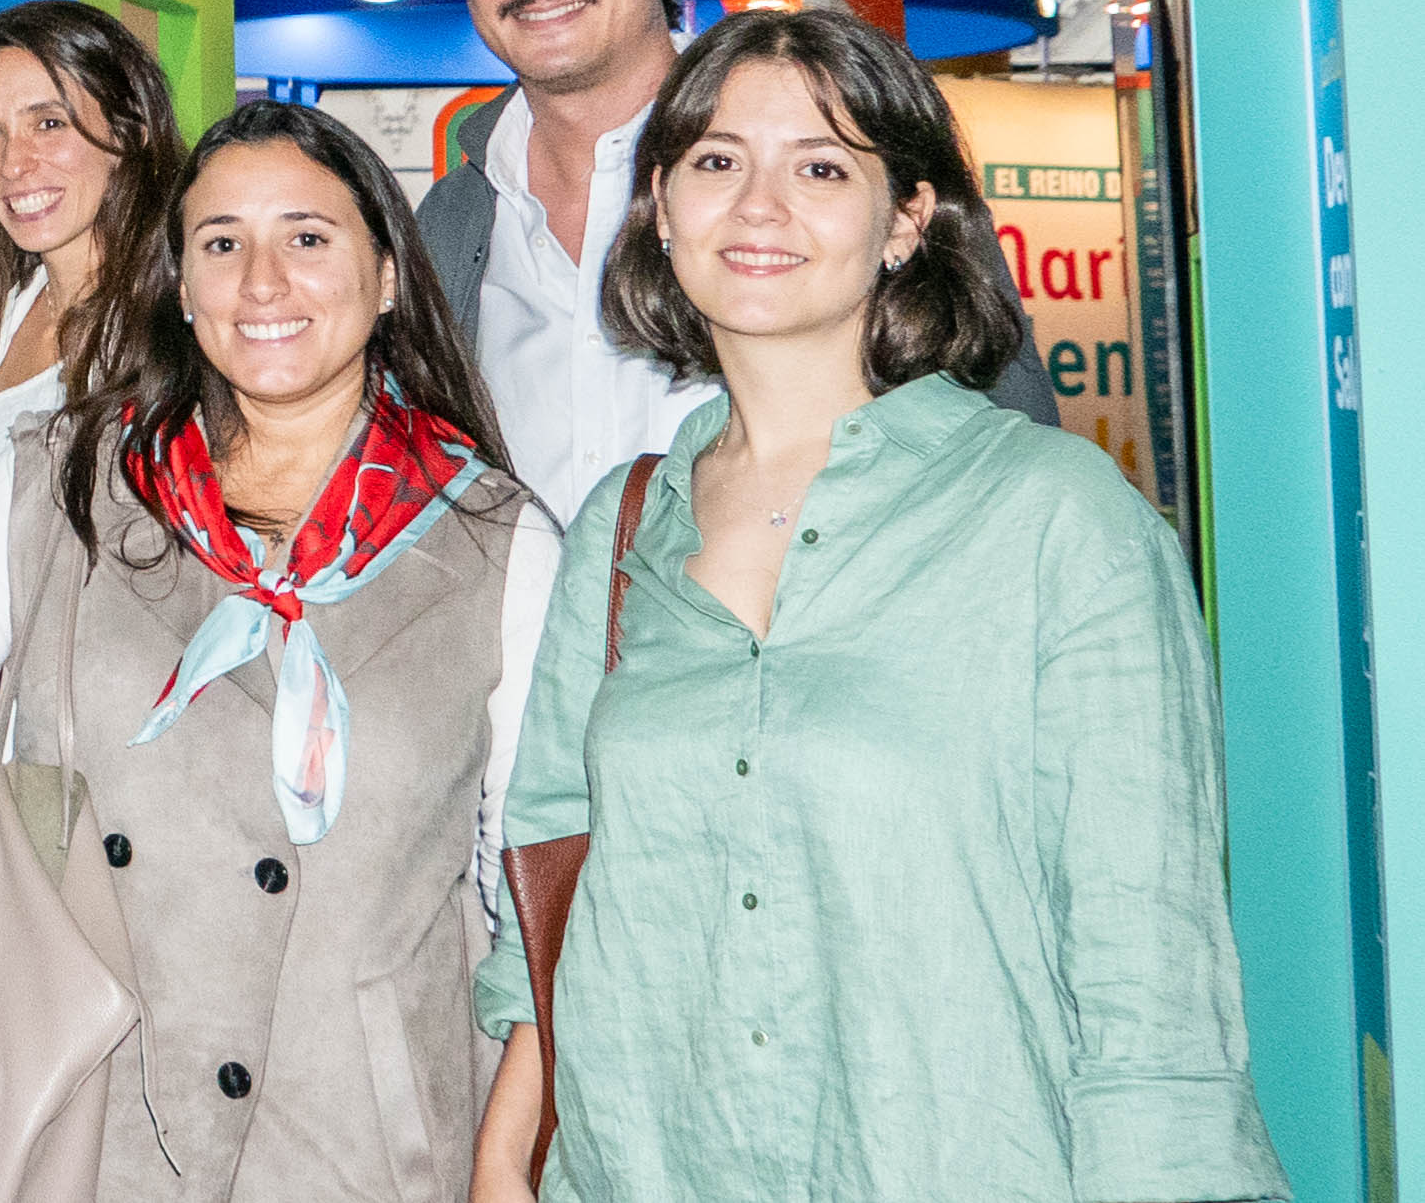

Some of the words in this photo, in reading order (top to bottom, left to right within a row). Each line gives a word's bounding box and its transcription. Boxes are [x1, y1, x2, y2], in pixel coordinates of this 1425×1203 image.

[994, 168, 1024, 196] EL
[1029, 169, 1100, 198] REINO
[1049, 339, 1134, 398] en
